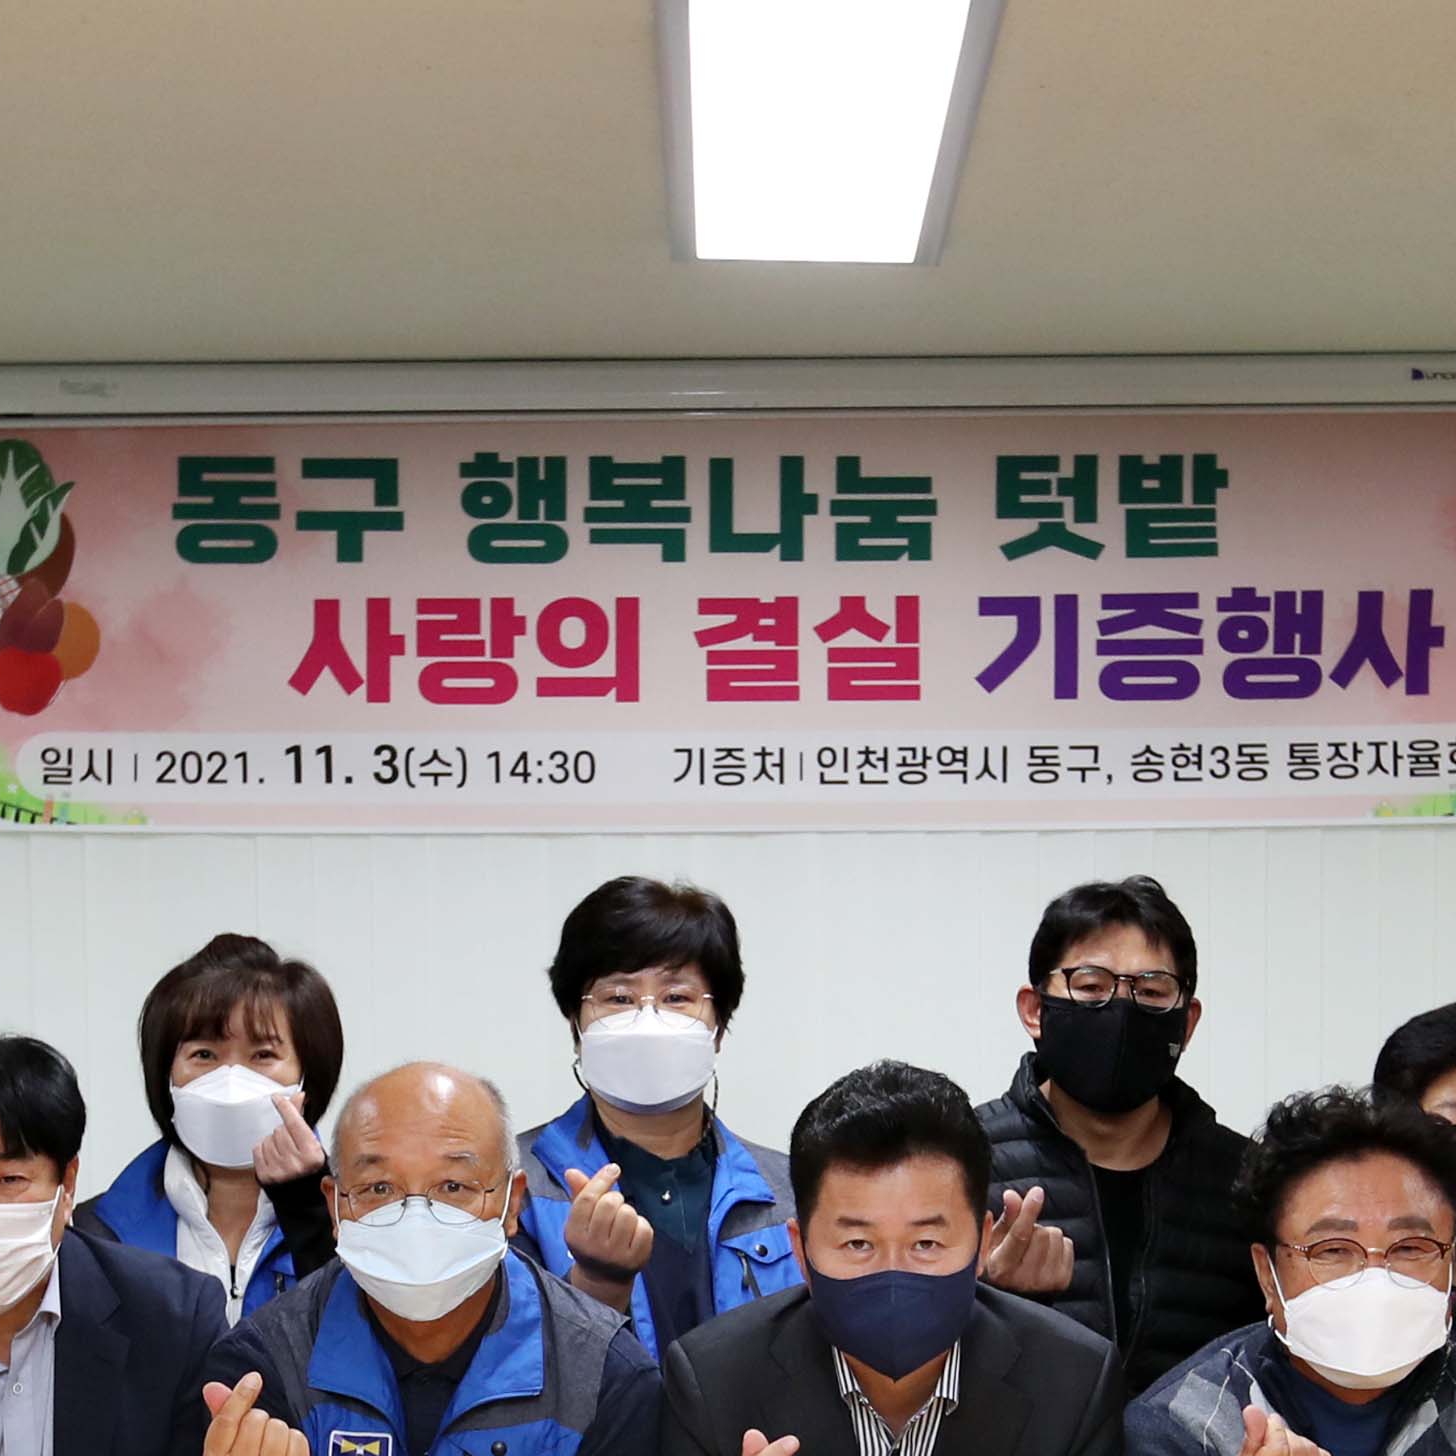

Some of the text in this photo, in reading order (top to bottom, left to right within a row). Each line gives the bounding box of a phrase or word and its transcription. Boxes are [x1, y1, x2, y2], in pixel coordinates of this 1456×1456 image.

[166, 448, 1229, 564] 동구 행복나눔 텃밭
[288, 586, 1446, 705] 사랑의 결실 기증행사
[40, 744, 596, 788] 일시 2021. 11. 3(수) 14:30
[674, 746, 784, 786] 기증처
[817, 745, 1008, 785] 인천광역시
[1027, 745, 1113, 784] 동구,
[1131, 742, 1270, 783] 송현3동
